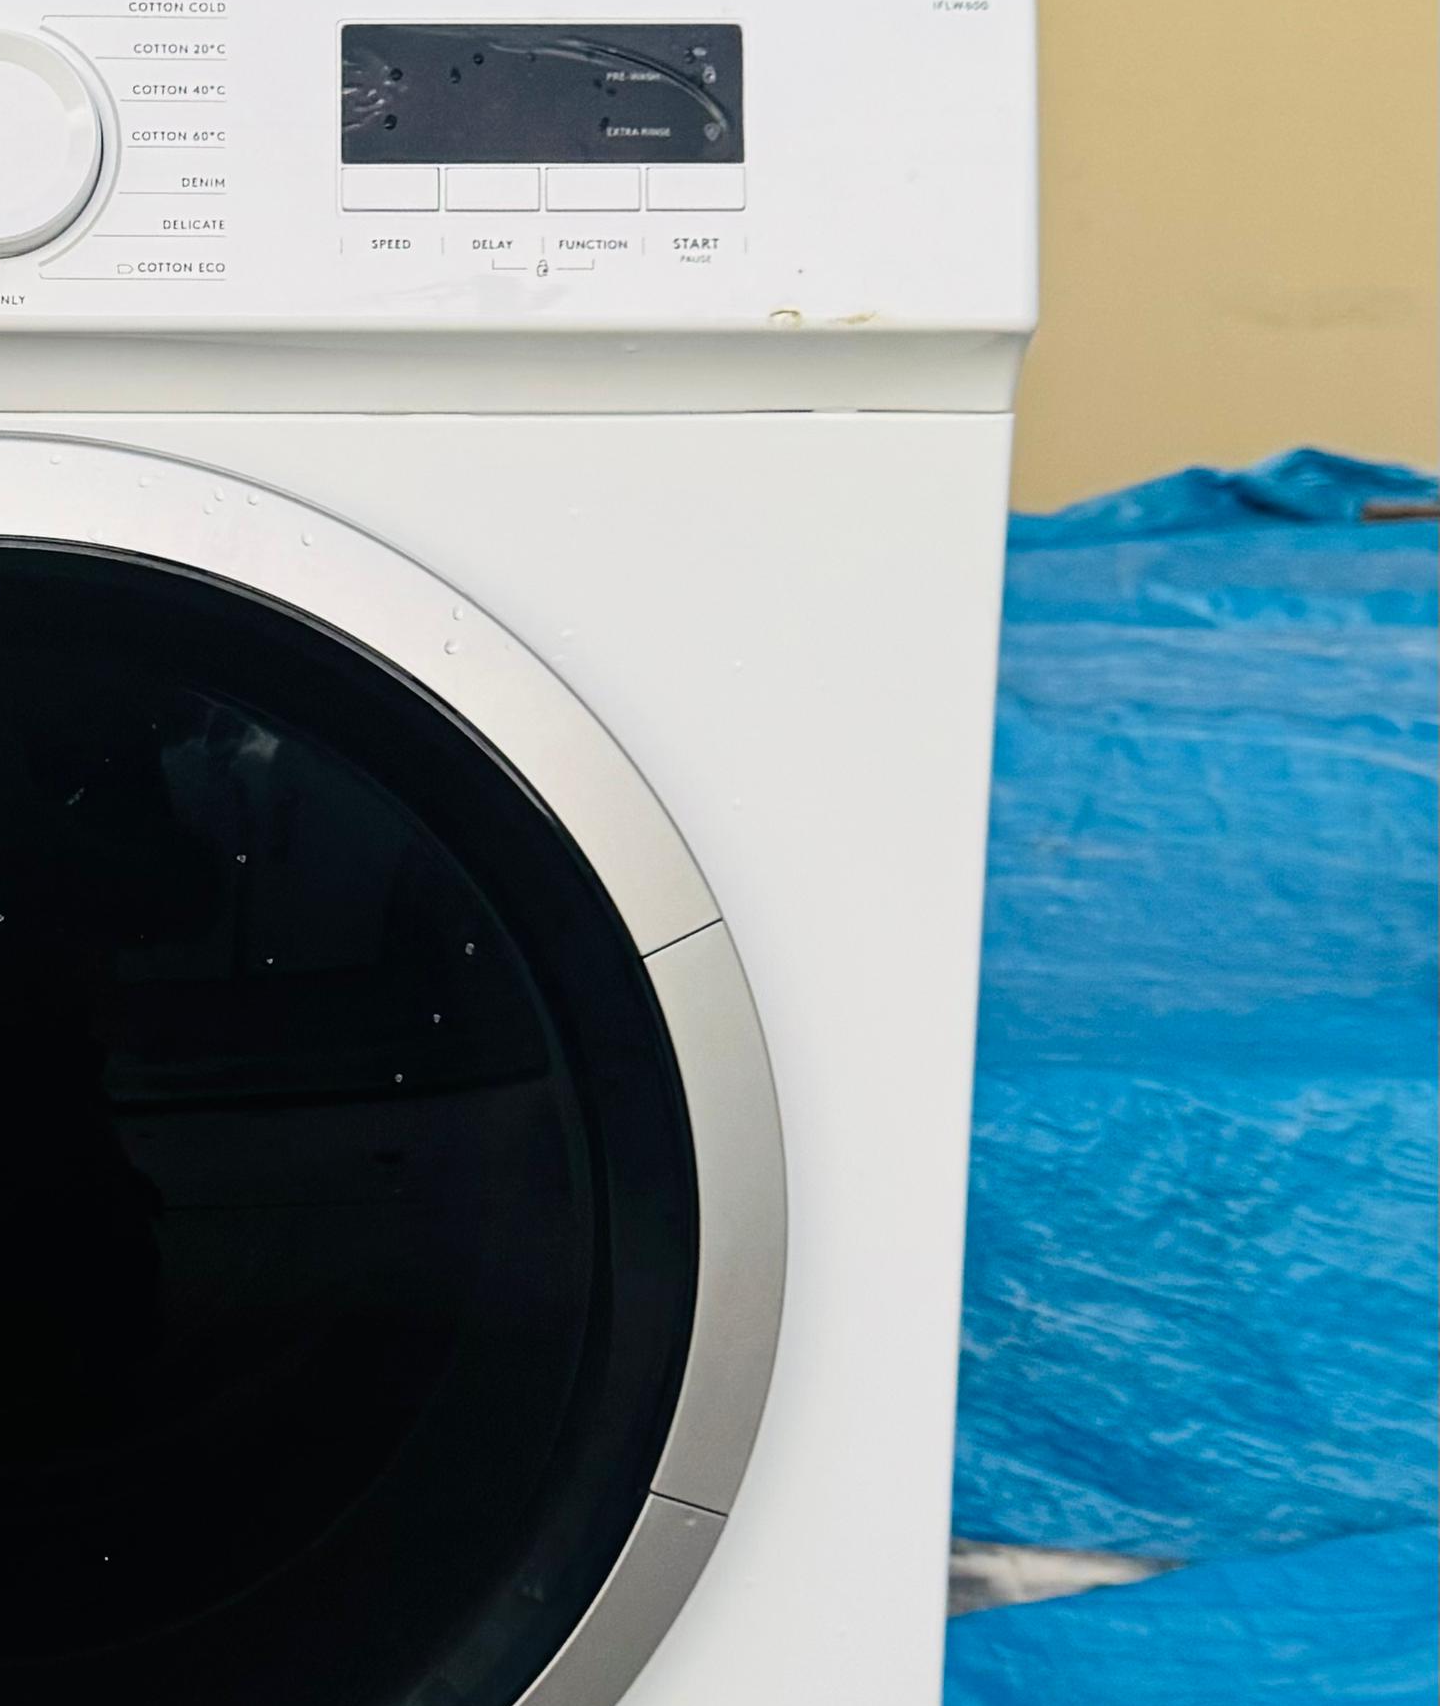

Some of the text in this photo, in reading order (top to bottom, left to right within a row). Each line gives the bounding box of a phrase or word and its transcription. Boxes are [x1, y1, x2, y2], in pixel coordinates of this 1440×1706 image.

[128, 2, 227, 13] COTTON COLD
[133, 43, 227, 54] COTTON 20°C
[132, 85, 227, 96] COTTON 40°C
[132, 131, 227, 141] COTTON 60°C
[606, 126, 638, 138] EXTRA
[181, 177, 226, 188] DENIM
[162, 219, 226, 231] DELICATE
[371, 238, 412, 250] SPEED
[472, 238, 514, 250] DELAY
[559, 238, 628, 251] FUNCTION
[673, 237, 720, 249] START
[137, 262, 226, 274] COTTON ECO
